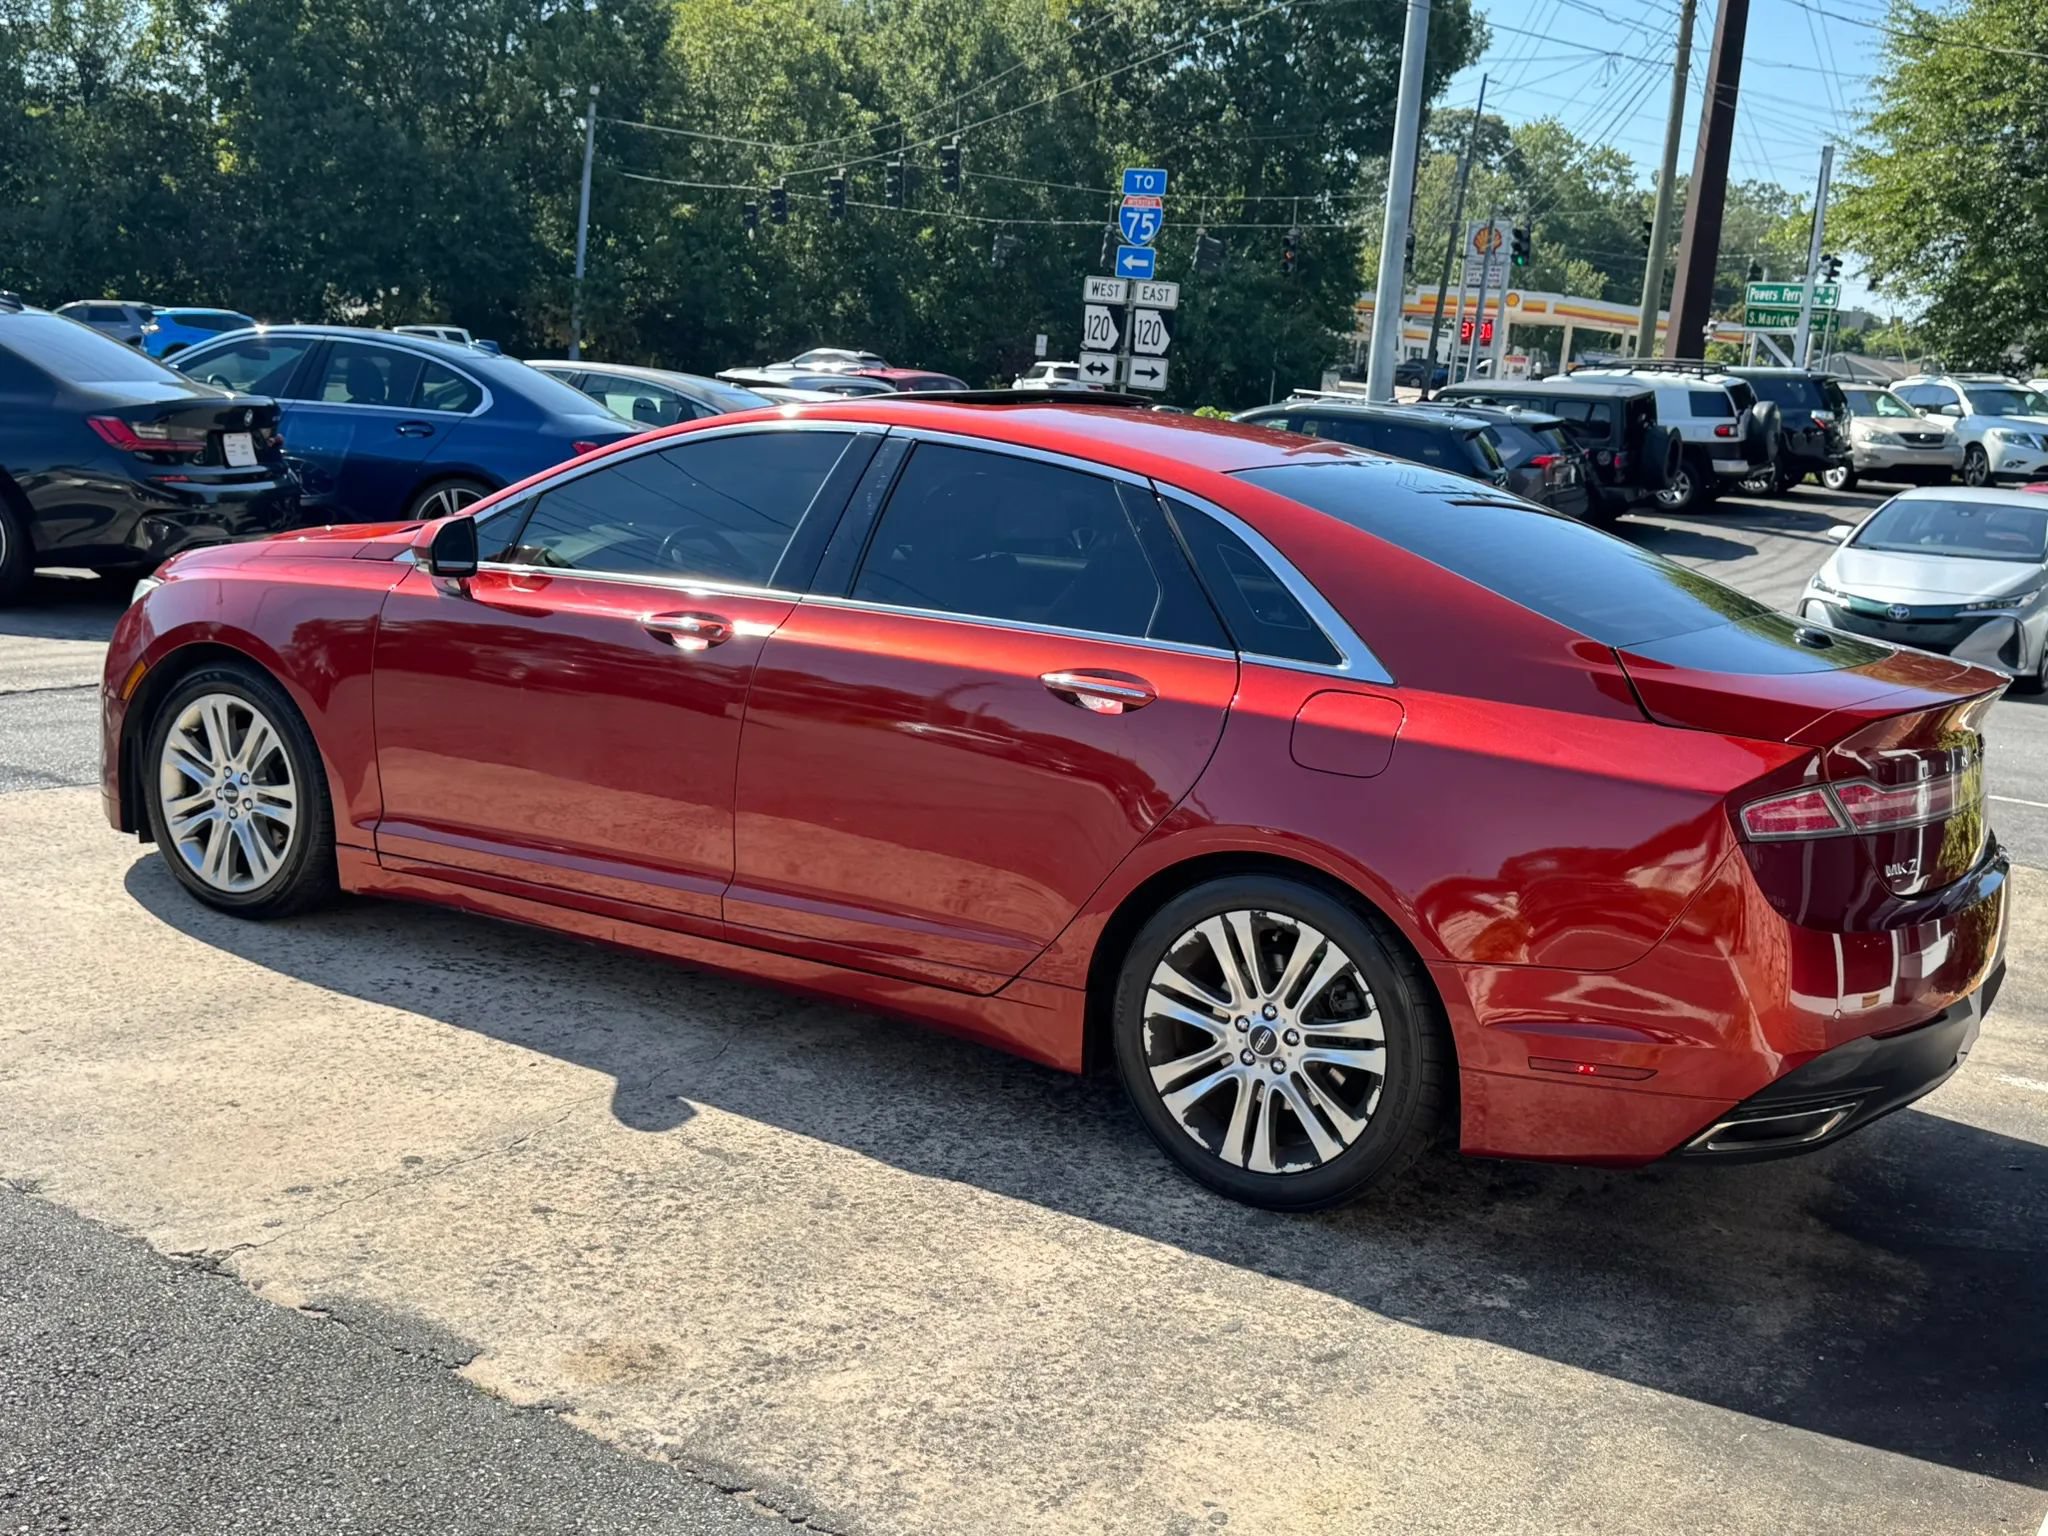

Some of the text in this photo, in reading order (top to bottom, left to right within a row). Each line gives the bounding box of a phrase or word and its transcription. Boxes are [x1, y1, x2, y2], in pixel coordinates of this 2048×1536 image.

[1134, 175, 1154, 189] TO
[1126, 212, 1155, 241] 75
[1092, 281, 1121, 298] WEST
[1142, 285, 1171, 303] EAST
[1750, 287, 1778, 301] Powers
[1087, 315, 1111, 342] 120
[1137, 319, 1161, 346] 120
[1885, 858, 1918, 878] MKZ
